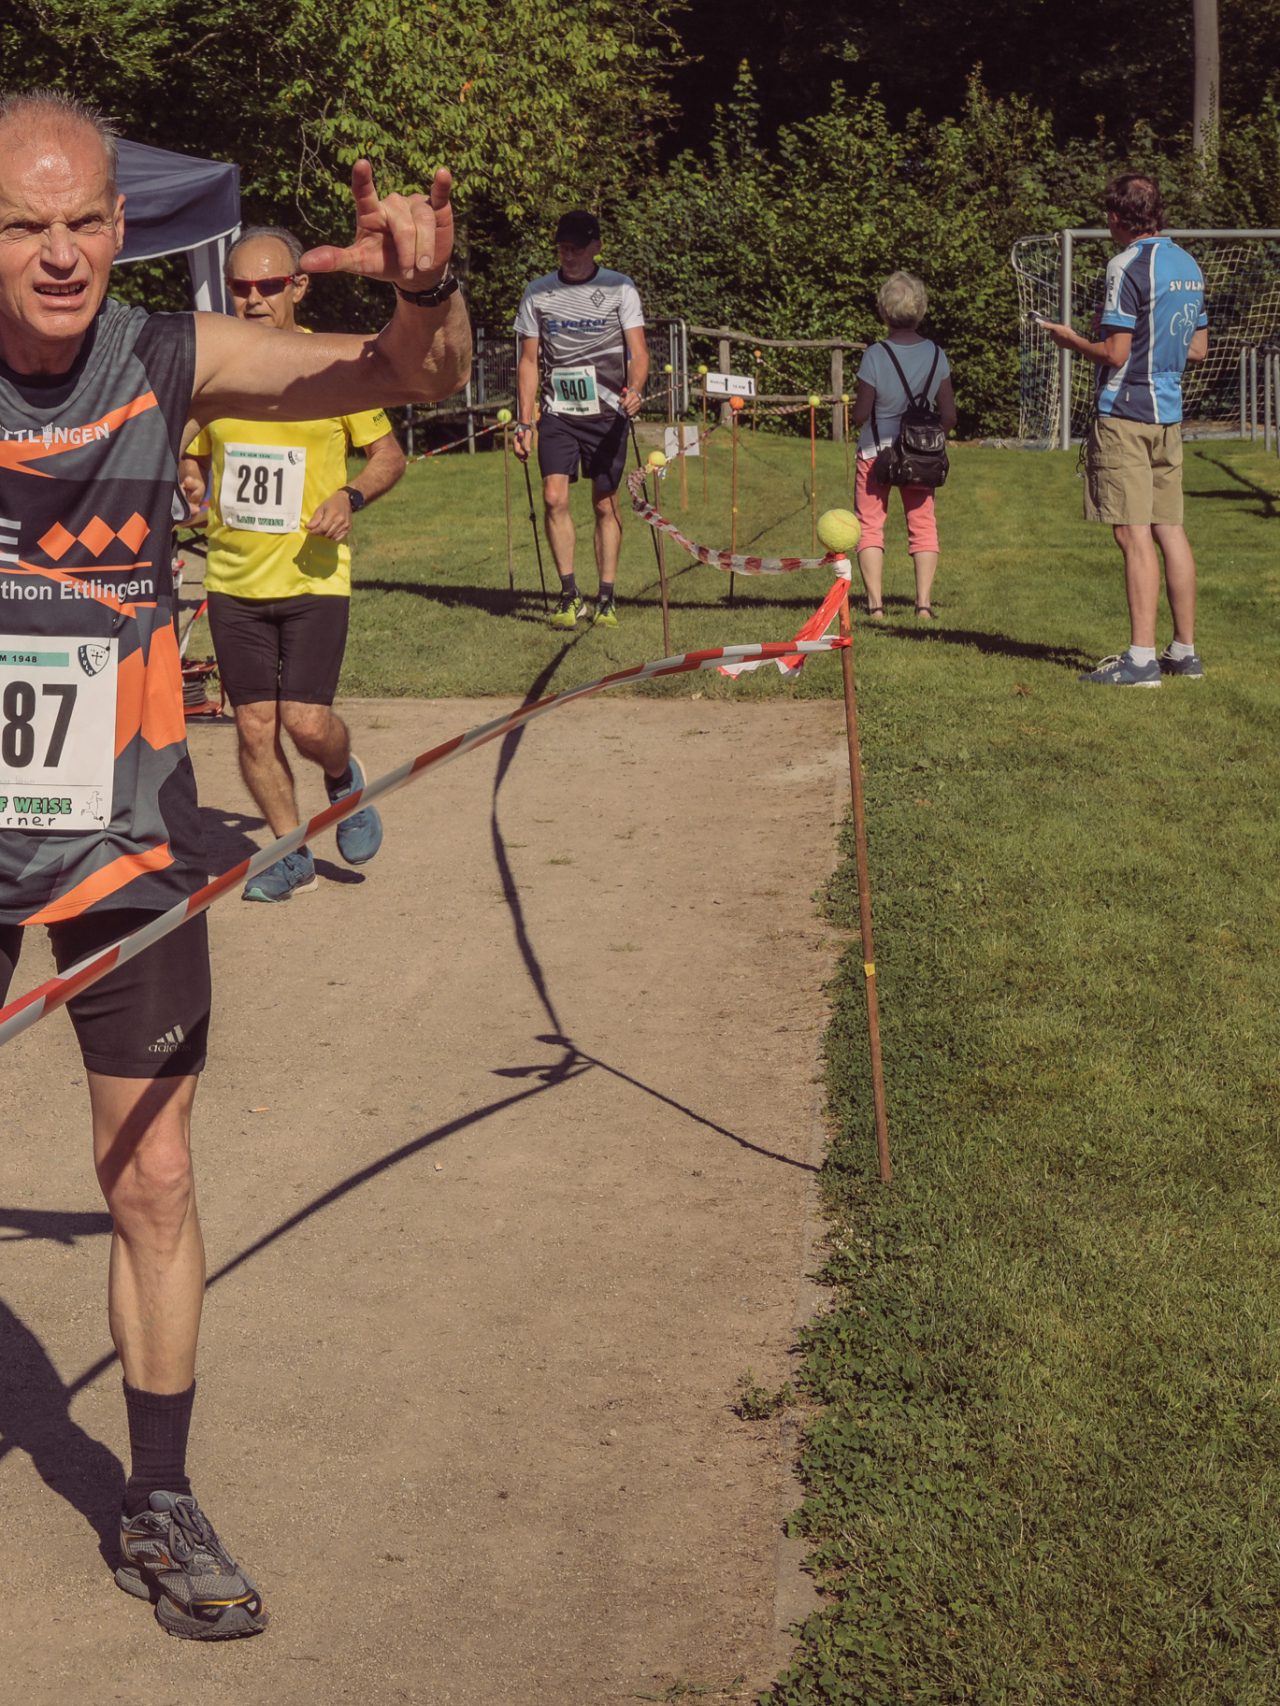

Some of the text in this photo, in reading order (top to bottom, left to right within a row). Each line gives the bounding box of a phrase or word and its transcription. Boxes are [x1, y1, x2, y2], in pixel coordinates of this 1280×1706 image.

[1169, 280, 1183, 292] SV
[560, 378, 587, 400] 640
[236, 464, 284, 506] 281
[60, 579, 154, 604] Ettlingen
[12, 654, 38, 663] 1948
[13, 796, 72, 815] WEISE
